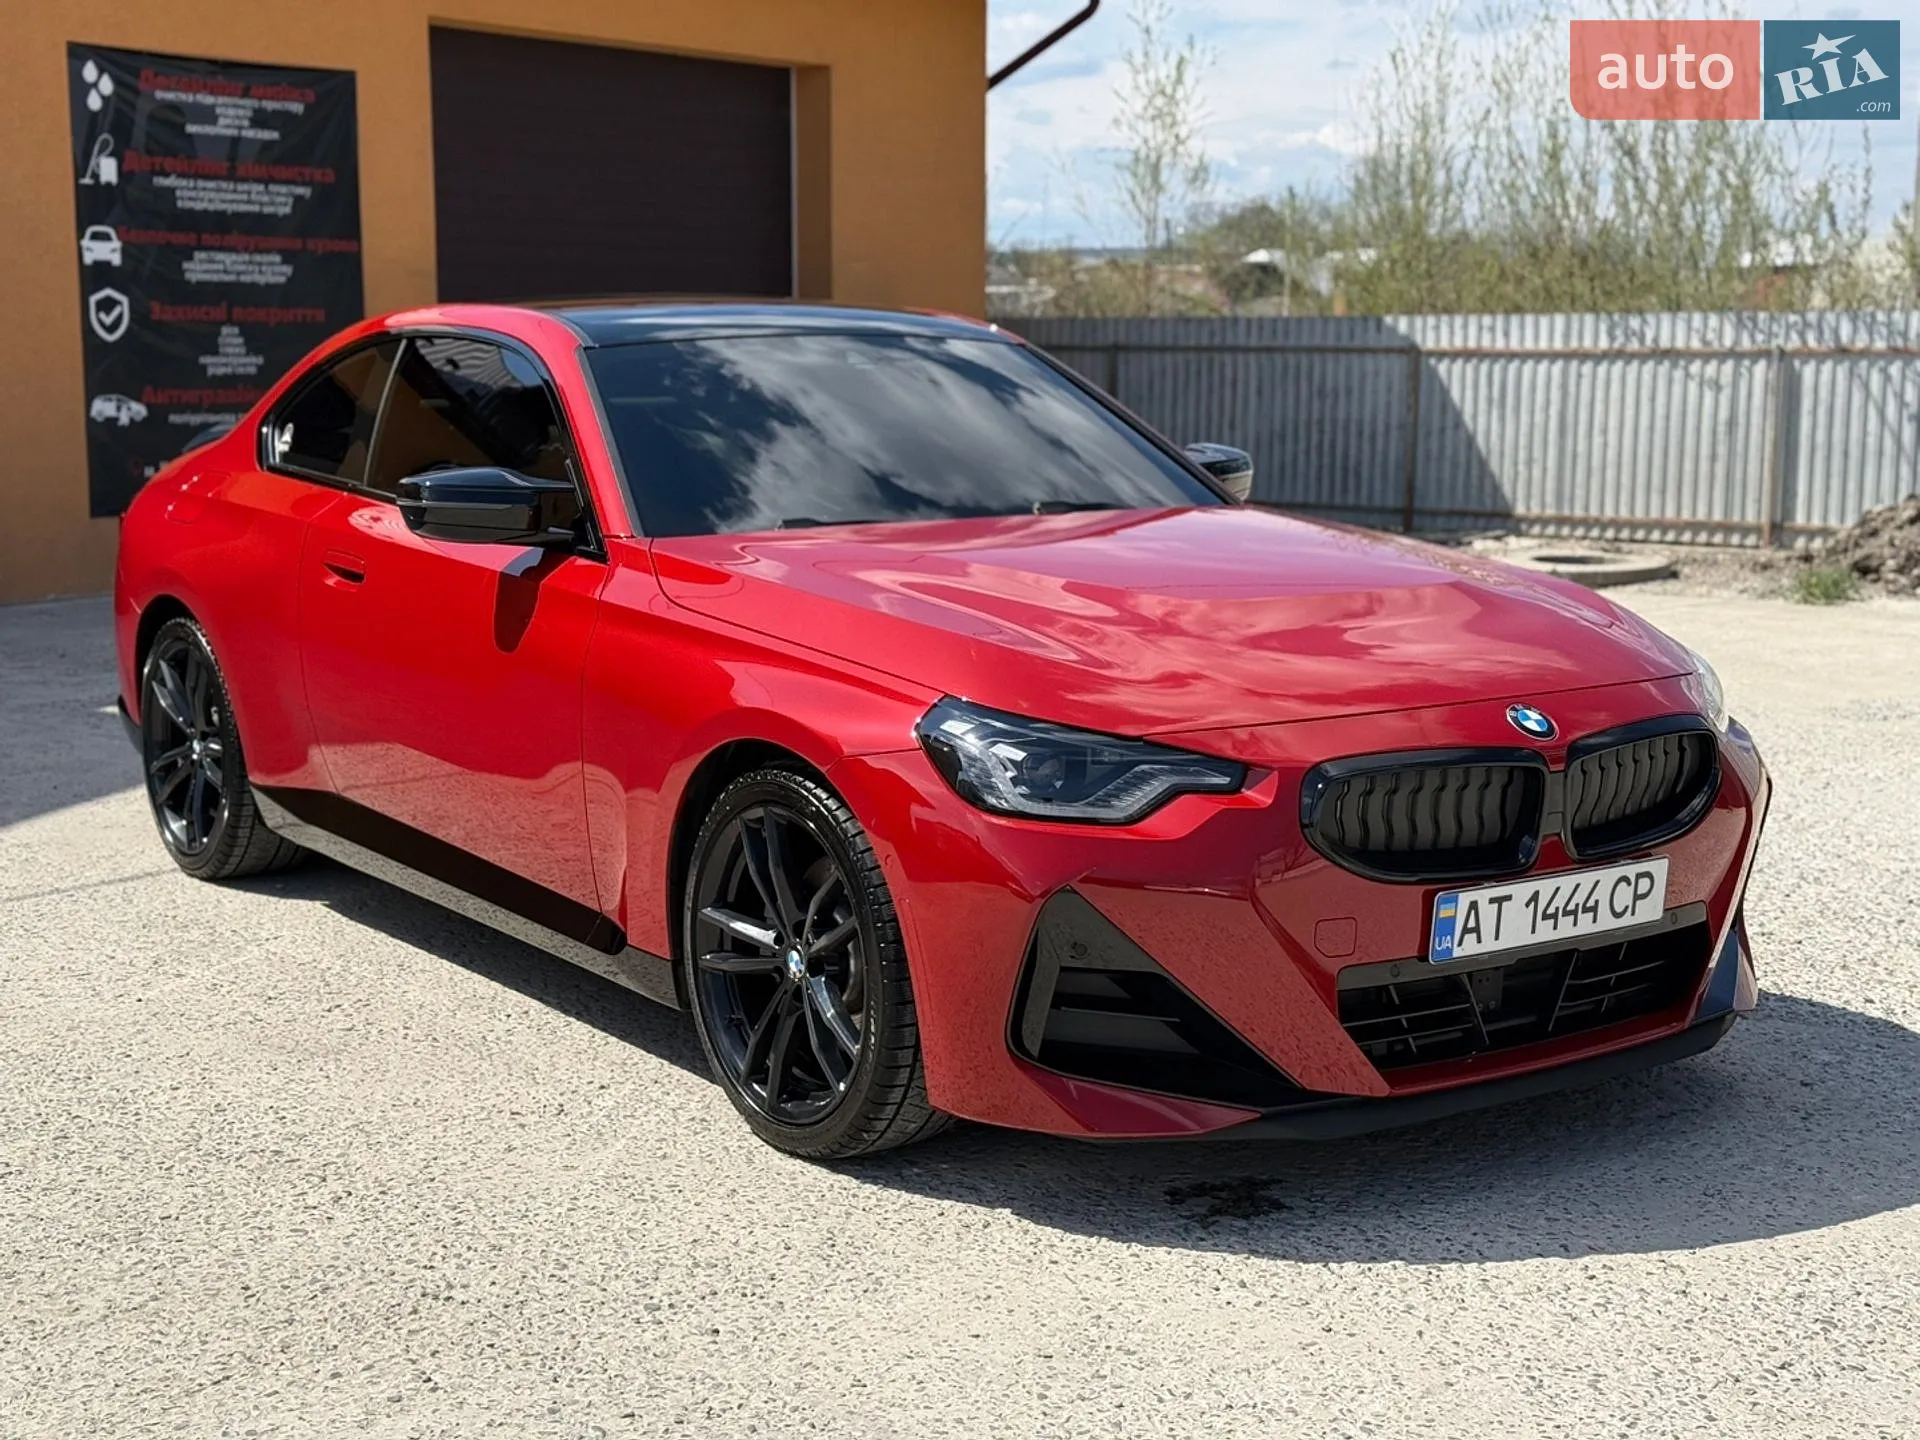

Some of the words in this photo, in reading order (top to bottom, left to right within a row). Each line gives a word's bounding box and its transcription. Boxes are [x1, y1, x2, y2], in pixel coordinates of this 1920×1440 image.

[1457, 894, 1513, 947] AT
[1525, 879, 1600, 935] 1444
[1609, 870, 1655, 919] CP
[1435, 936, 1452, 950] UA
